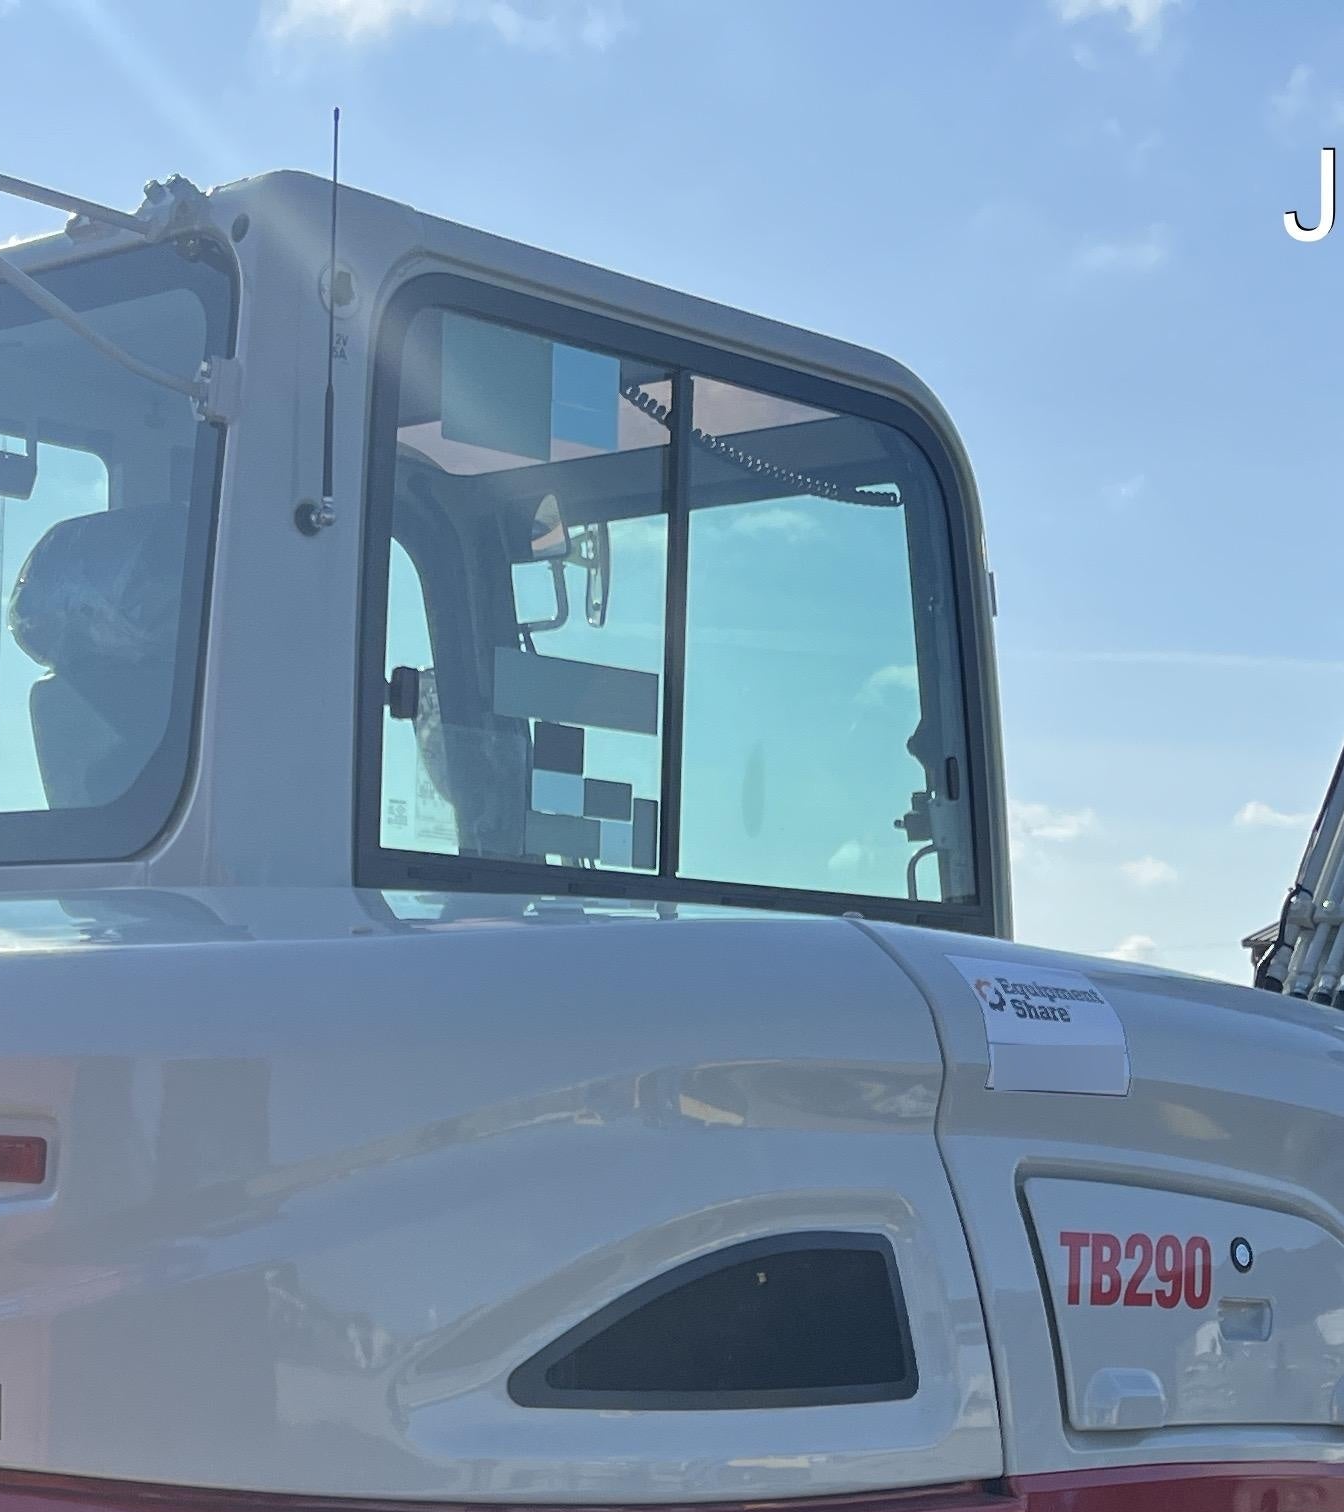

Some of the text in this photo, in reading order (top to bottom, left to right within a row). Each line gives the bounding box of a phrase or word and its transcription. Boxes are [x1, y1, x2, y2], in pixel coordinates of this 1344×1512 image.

[995, 977, 1105, 1005] Equipment
[1010, 999, 1071, 1023] Share
[1059, 1231, 1212, 1310] TB290
